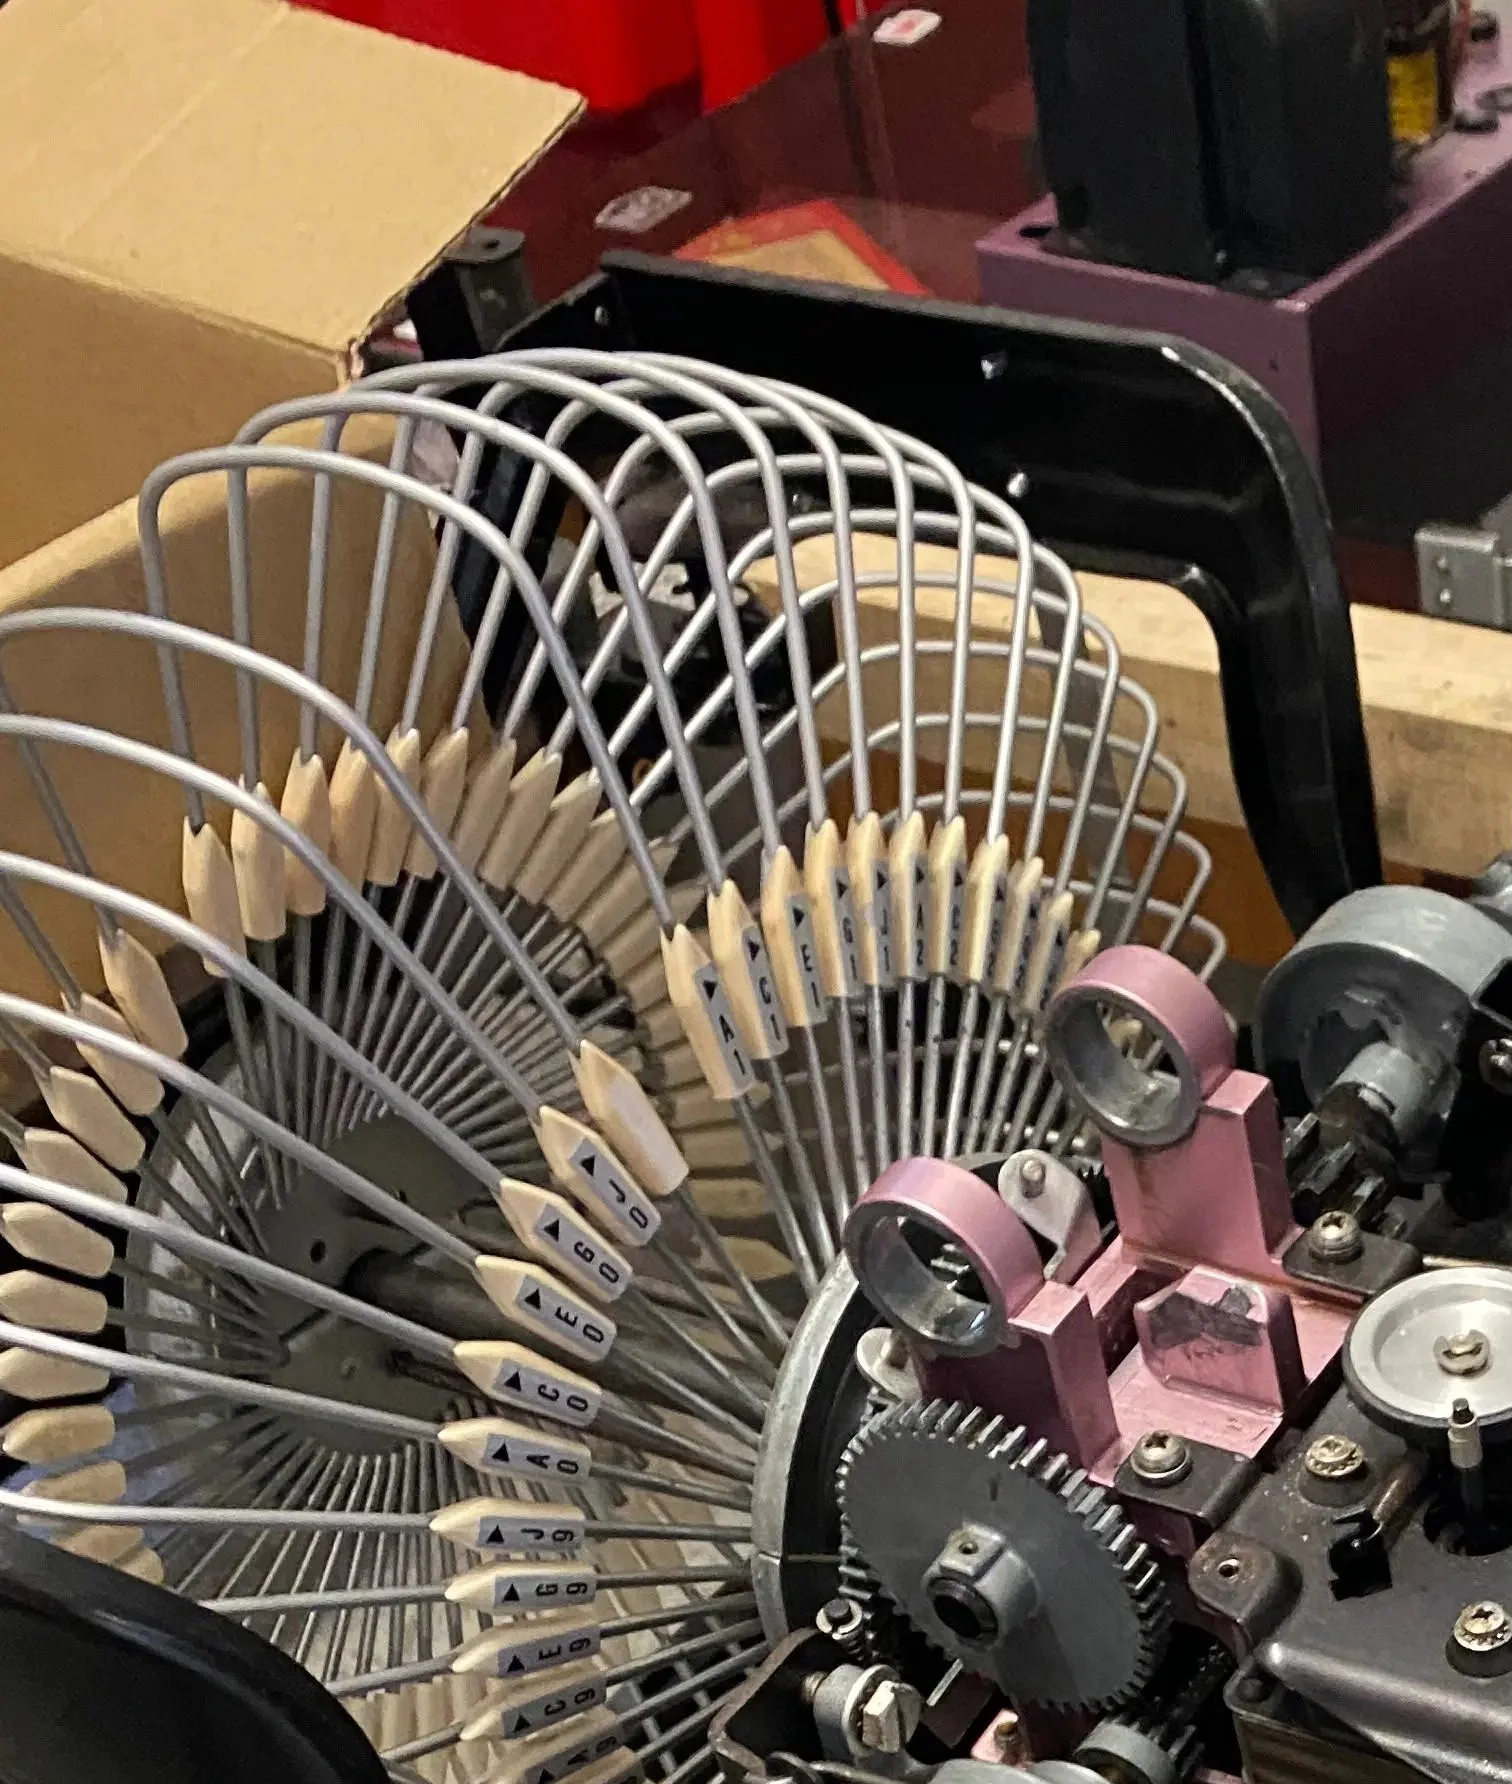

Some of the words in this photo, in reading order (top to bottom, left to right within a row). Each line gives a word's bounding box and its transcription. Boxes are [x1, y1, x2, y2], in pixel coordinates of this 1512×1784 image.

[800, 944, 821, 1009] E1
[717, 1015, 749, 1076] A1
[521, 1527, 576, 1543] J9
[535, 1581, 589, 1598] G9
[537, 1636, 592, 1661] E9
[543, 1687, 596, 1717] C9
